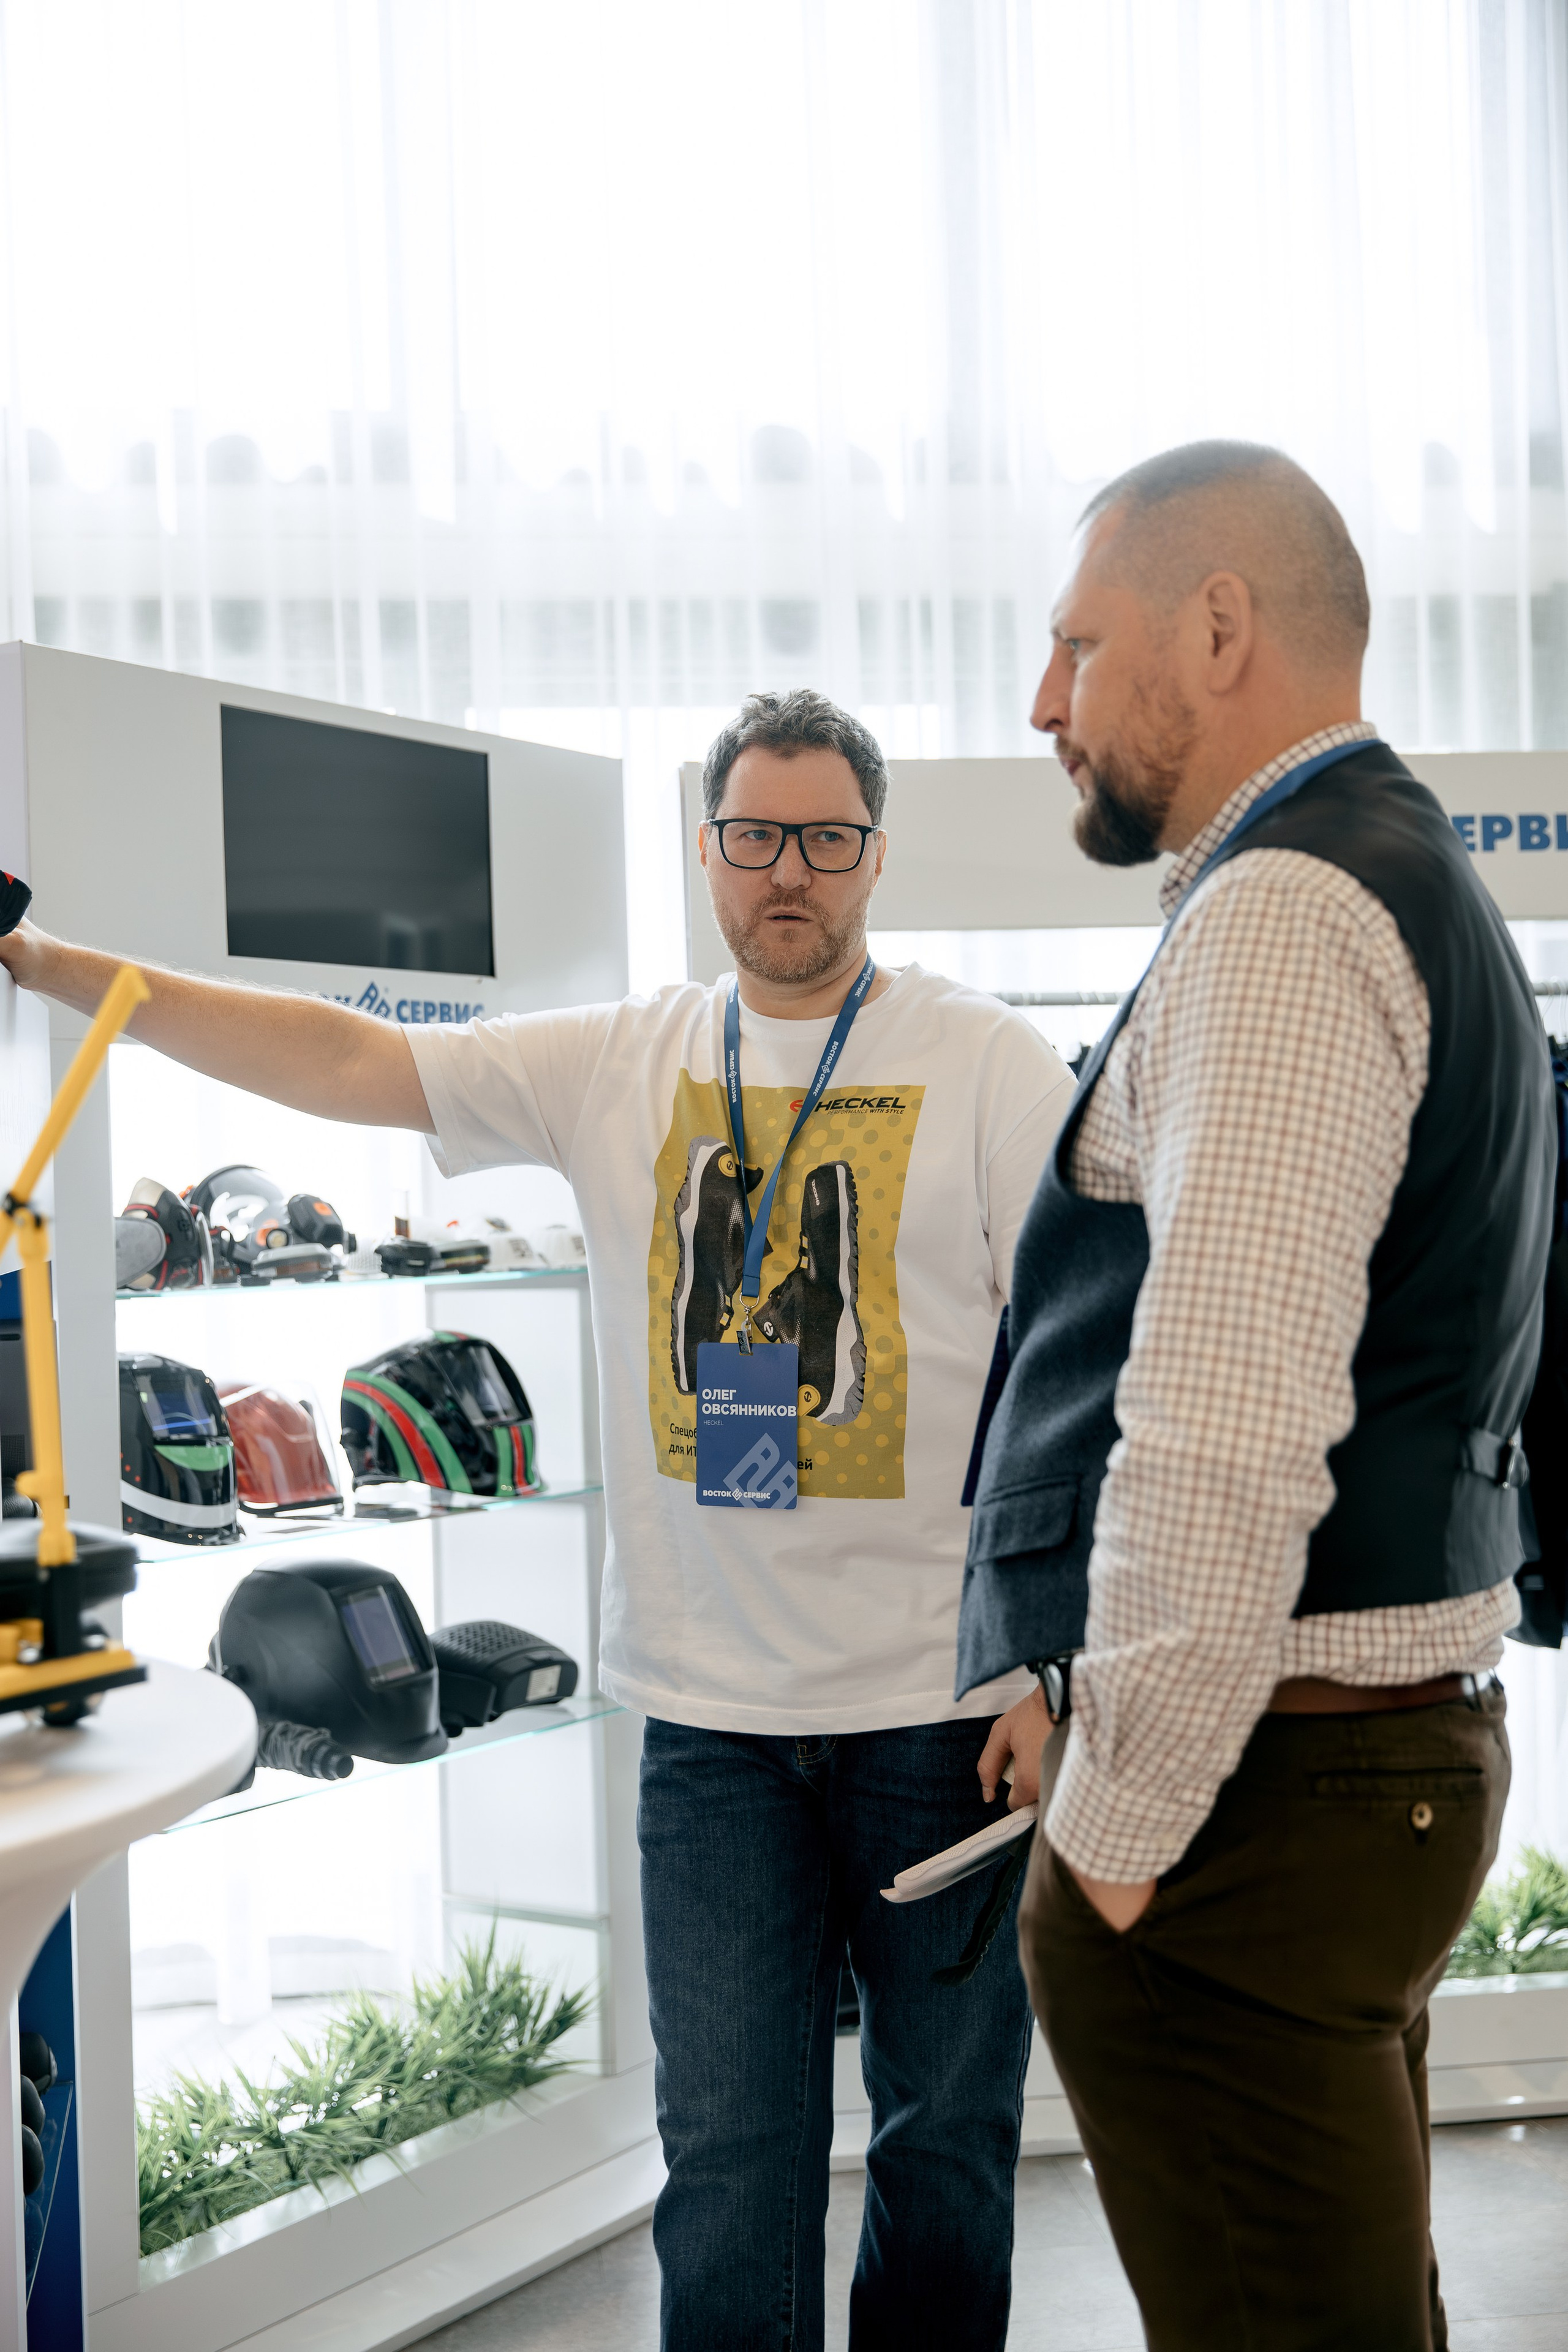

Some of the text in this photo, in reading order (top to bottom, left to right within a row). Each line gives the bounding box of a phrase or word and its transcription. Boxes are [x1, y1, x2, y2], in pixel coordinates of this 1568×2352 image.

[854, 980, 867, 997] СЕРВИС
[813, 1041, 839, 1097] ВОСТОК СЕРВИС
[815, 1097, 906, 1112] HECKEL
[701, 1389, 737, 1400] ОЛЕГ
[701, 1403, 797, 1417] ОВСЯННИКОВ
[670, 1423, 697, 1439] Спецоб
[668, 1444, 697, 1457] для ИТ
